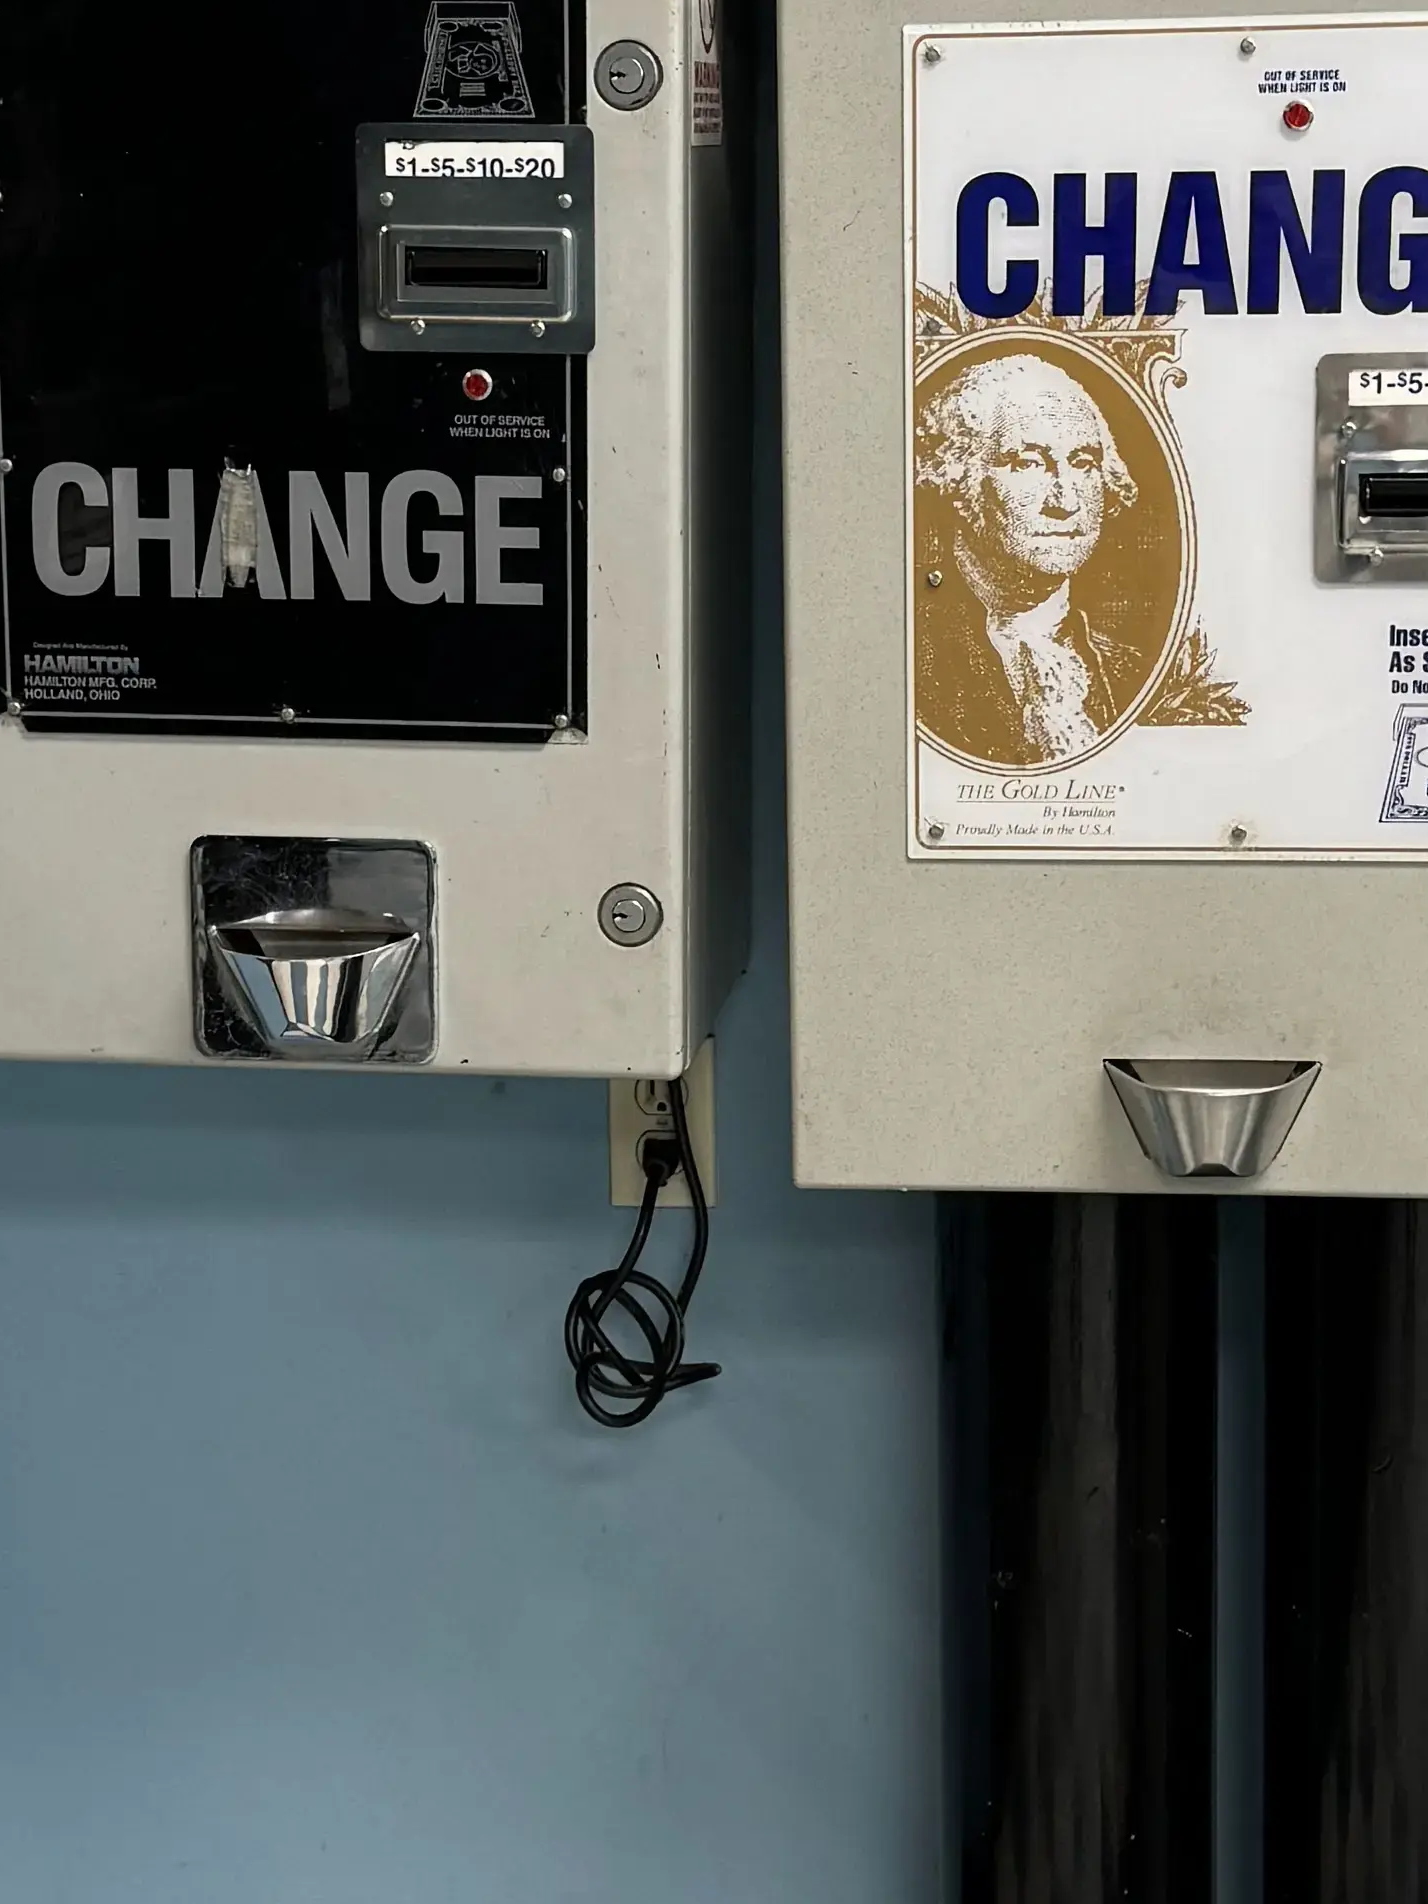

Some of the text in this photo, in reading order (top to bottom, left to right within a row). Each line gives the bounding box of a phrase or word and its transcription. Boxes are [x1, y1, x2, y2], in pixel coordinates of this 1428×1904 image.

[1264, 69, 1340, 81] OUT OF SERVICE
[1258, 81, 1346, 93] WHEN LIGHT IS ON
[396, 156, 556, 178] $1-$5-$10-$20
[454, 414, 545, 426] OUT OF SERVICE
[449, 427, 550, 439] WHEN LIGHT IS ON
[31, 461, 544, 605] CHANGE
[23, 654, 140, 675] HAMILTON
[1389, 651, 1416, 673] As
[24, 675, 157, 689] HAMILTON MFG. CORP.
[1391, 680, 1408, 694] Do
[24, 688, 121, 702] HOLLAND, OHIO
[956, 784, 995, 800] THE
[1001, 779, 1059, 800] GOLD
[1042, 806, 1116, 820] By Hamilton
[955, 823, 1003, 838] Proudly
[1005, 823, 1038, 836] Made
[1042, 824, 1054, 836] in
[1057, 823, 1075, 836] the
